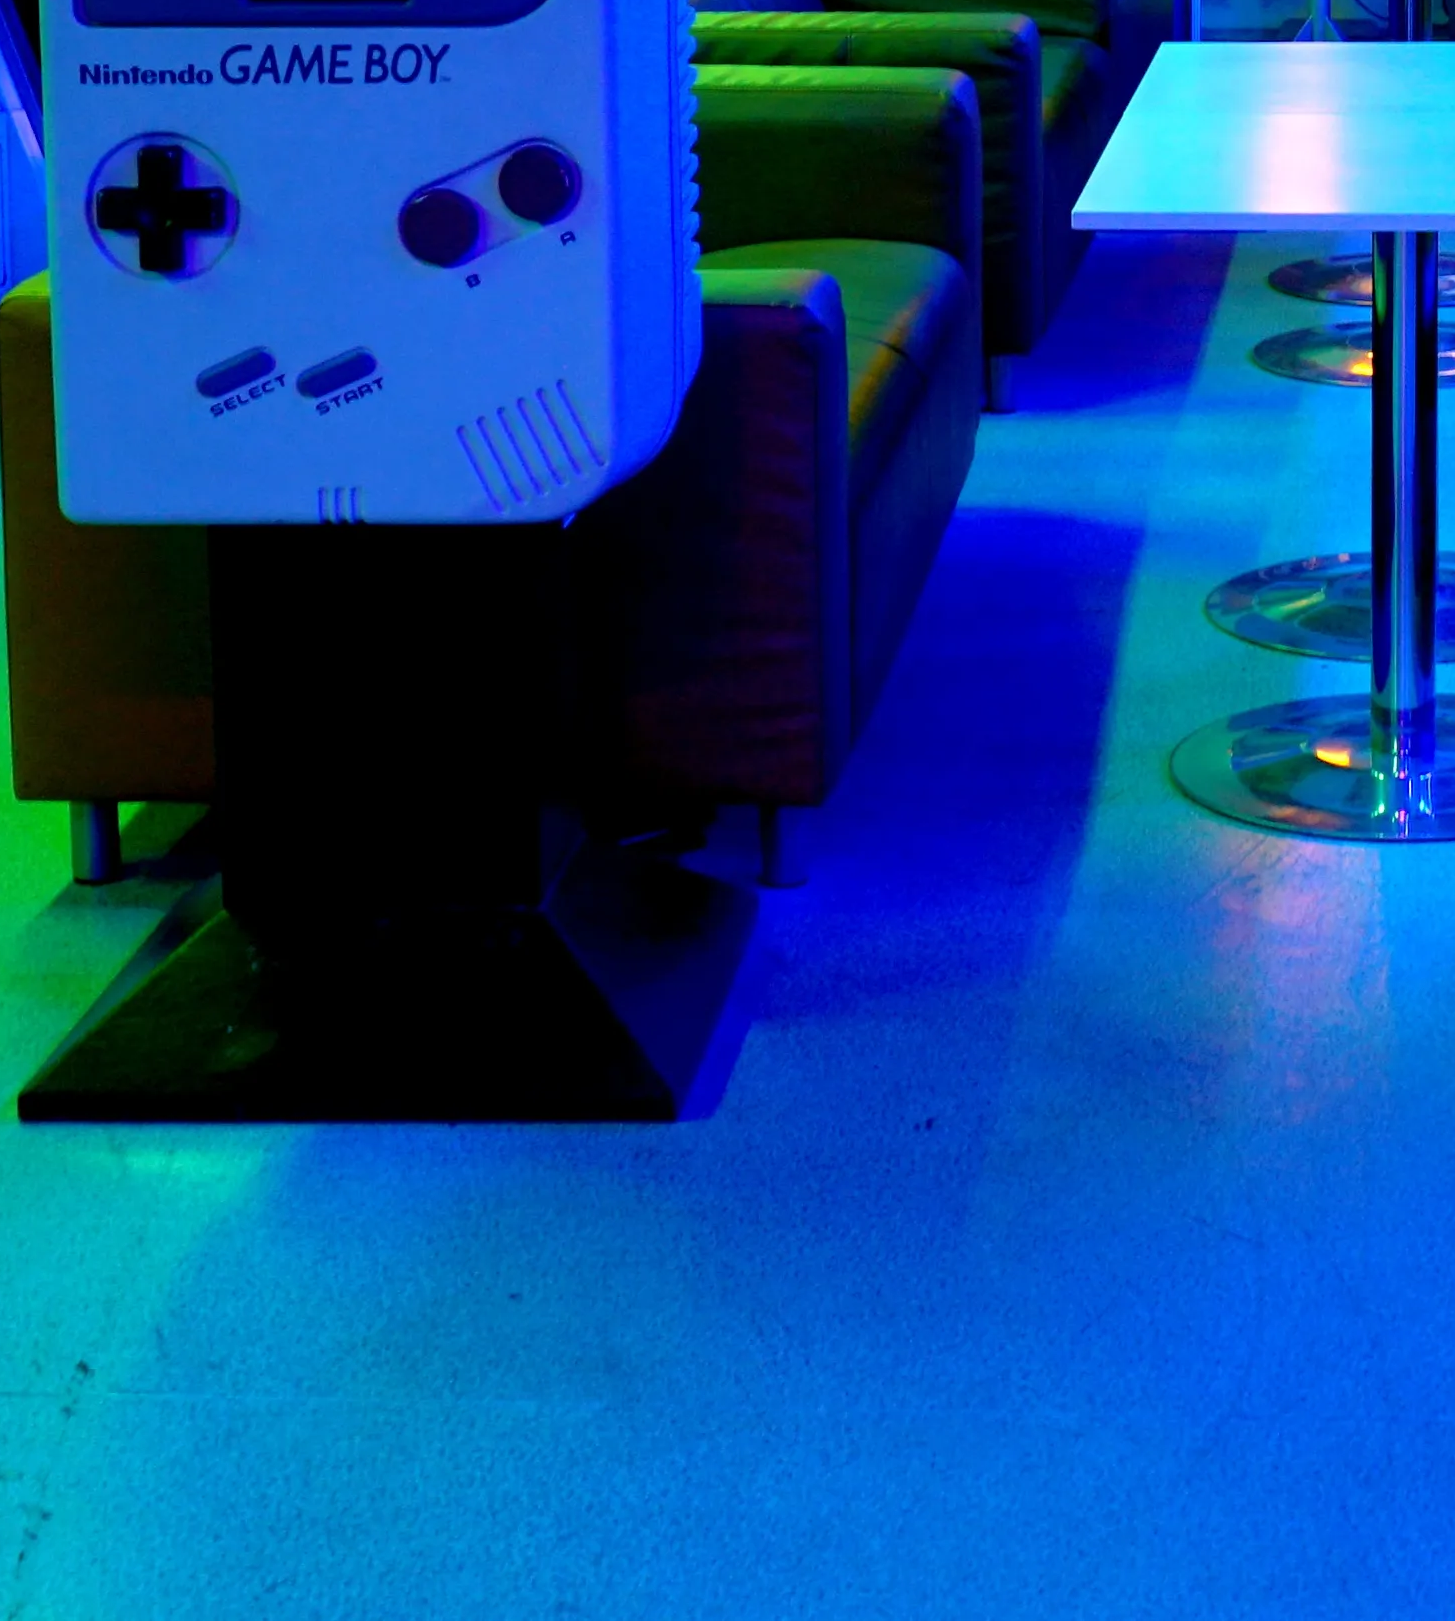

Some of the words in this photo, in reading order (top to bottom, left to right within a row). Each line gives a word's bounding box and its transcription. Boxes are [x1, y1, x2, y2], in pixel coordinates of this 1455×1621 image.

[79, 63, 214, 86] Nintendo
[219, 43, 353, 86] GAME
[363, 43, 451, 85] BOY
[558, 229, 577, 246] A
[465, 273, 482, 289] B
[209, 374, 287, 419] SELECT
[315, 377, 385, 417] START
